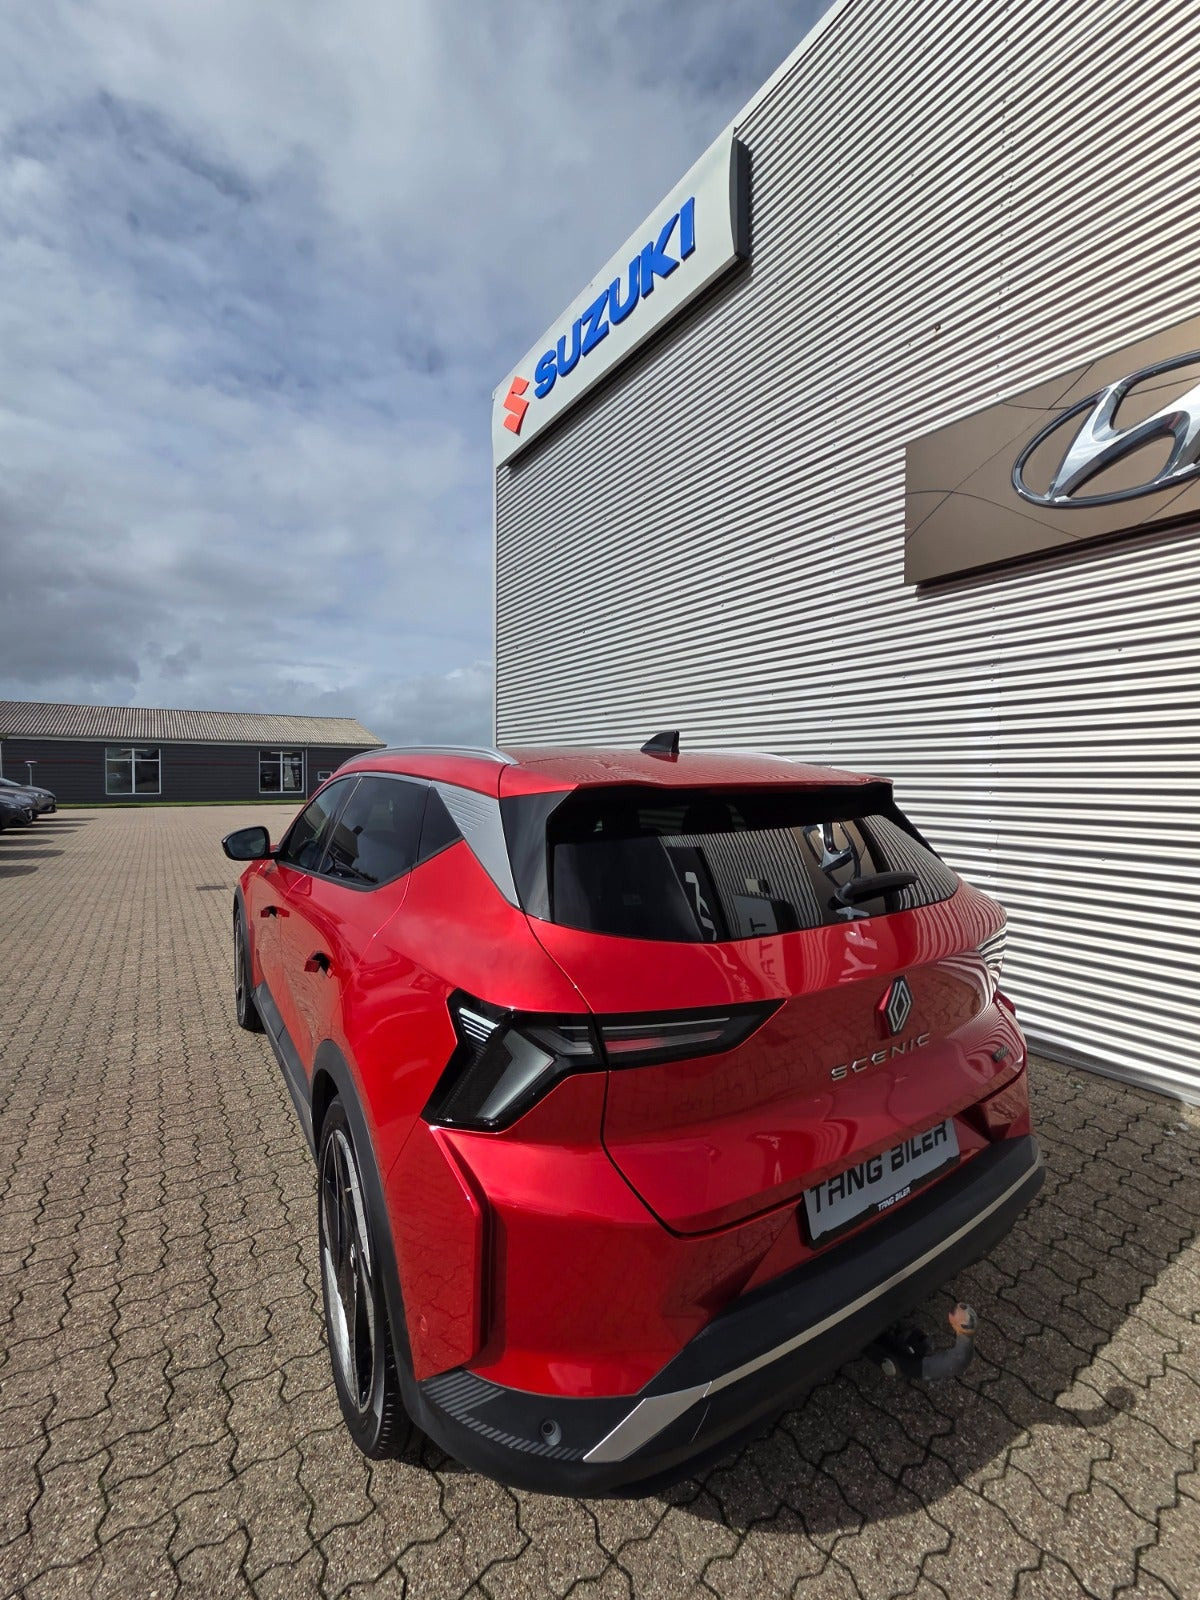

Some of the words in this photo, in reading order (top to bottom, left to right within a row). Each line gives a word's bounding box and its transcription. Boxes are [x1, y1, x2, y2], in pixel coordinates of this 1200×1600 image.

[533, 196, 696, 400] SUZUKI
[831, 1032, 930, 1081] SCENIC
[810, 1153, 883, 1213] TANG
[890, 1121, 948, 1172] BILER
[877, 1196, 895, 1212] TANG
[894, 1186, 911, 1202] BILER
